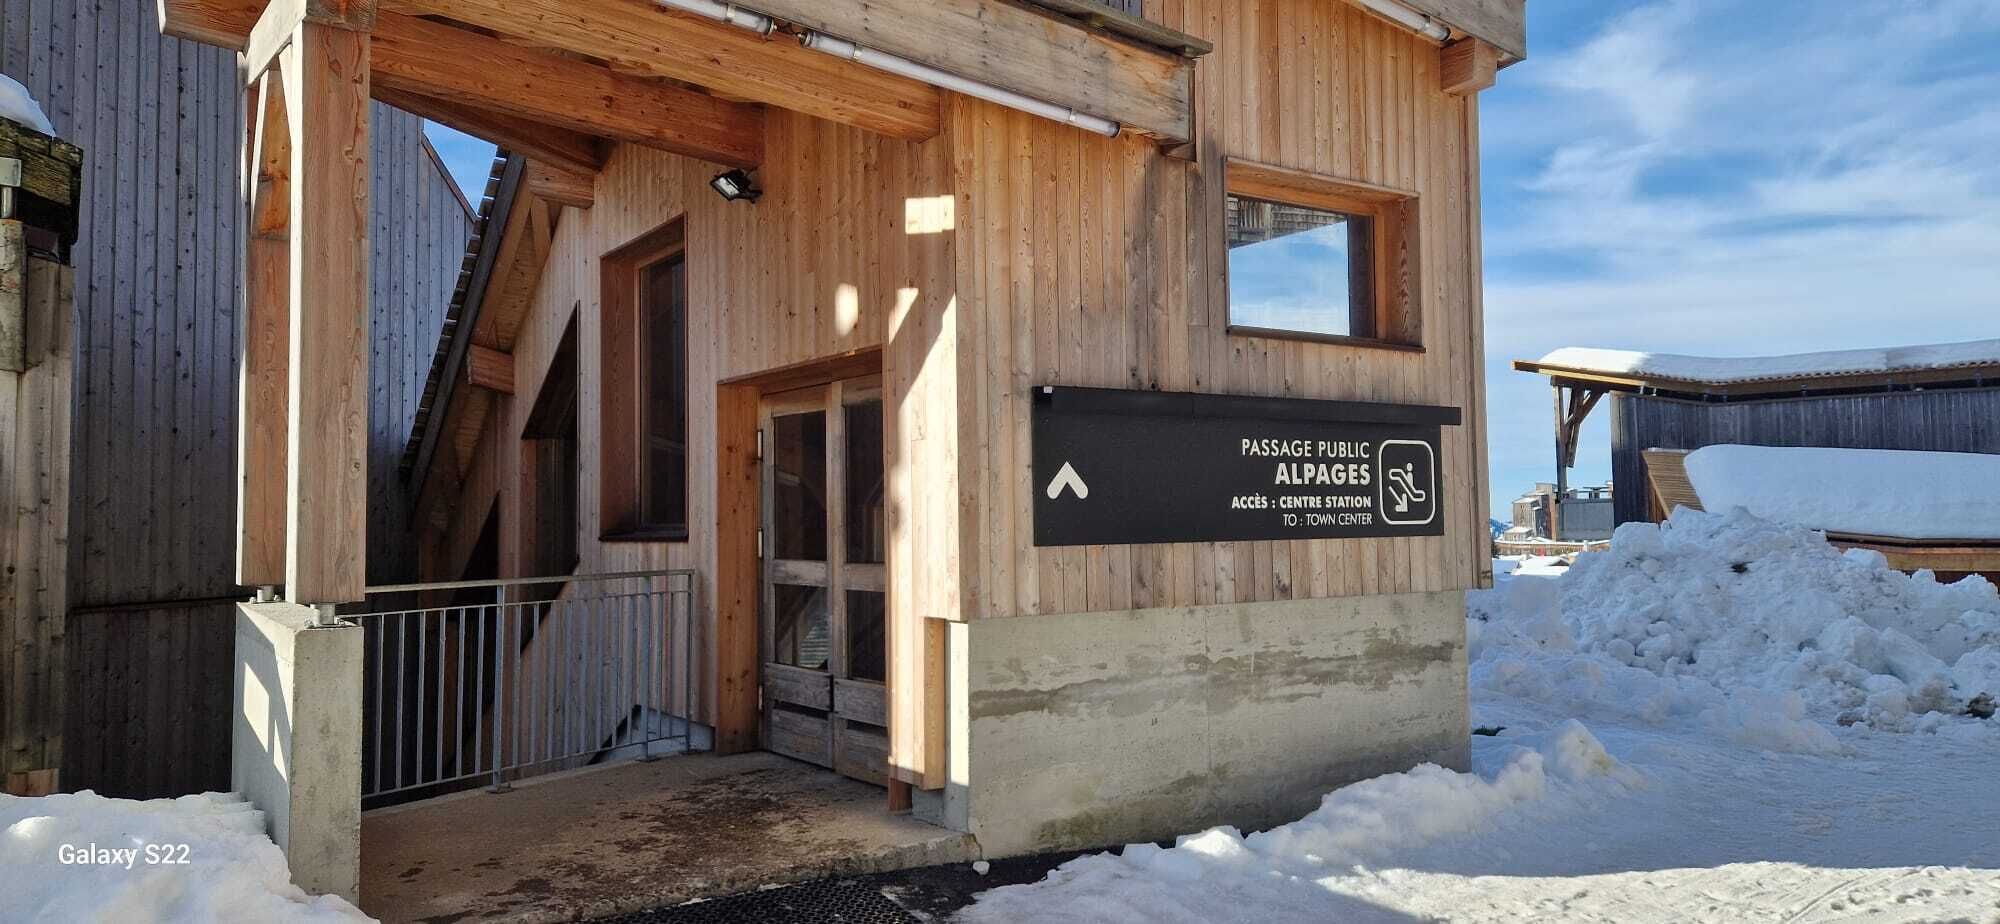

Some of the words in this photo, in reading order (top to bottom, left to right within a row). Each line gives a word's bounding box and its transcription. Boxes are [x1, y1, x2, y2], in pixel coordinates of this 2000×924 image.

[1242, 438, 1312, 457] PASSAGE
[1318, 440, 1370, 459] PUBLIC
[1274, 462, 1371, 486] ALPAGES
[1231, 493, 1268, 509] ACCÈS
[1279, 495, 1322, 509] CENTRE
[1325, 495, 1372, 509] STATION
[1283, 513, 1298, 527] TO
[1305, 513, 1336, 526] TOWN
[1338, 512, 1372, 526] CENTER
